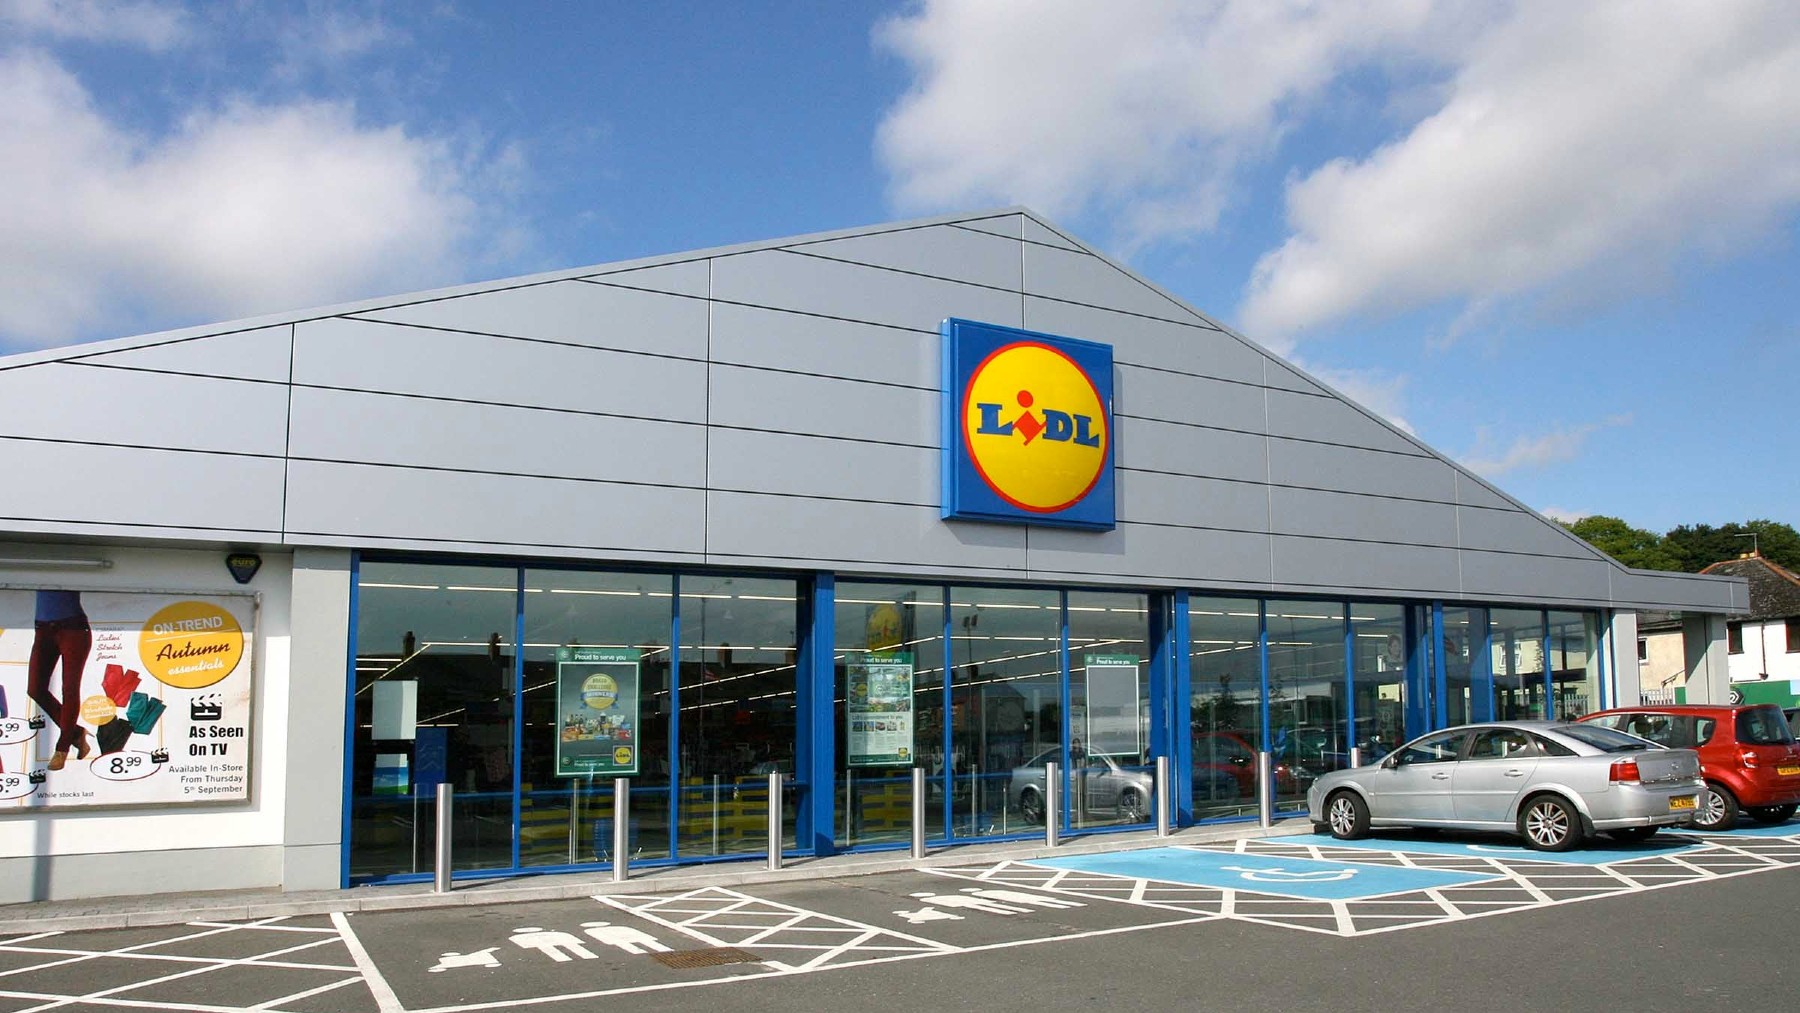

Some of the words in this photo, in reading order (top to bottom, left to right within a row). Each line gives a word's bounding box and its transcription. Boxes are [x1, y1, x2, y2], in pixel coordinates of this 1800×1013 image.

[153, 616, 222, 635] ON-TREND
[96, 652, 116, 662] Jeans
[156, 641, 230, 661] Autumn
[168, 658, 224, 675] essentials
[189, 726, 206, 738] As
[210, 726, 244, 738] Seen
[190, 744, 207, 756] On
[211, 743, 228, 756] TV
[110, 756, 142, 774] 8.99
[198, 785, 242, 794] September
